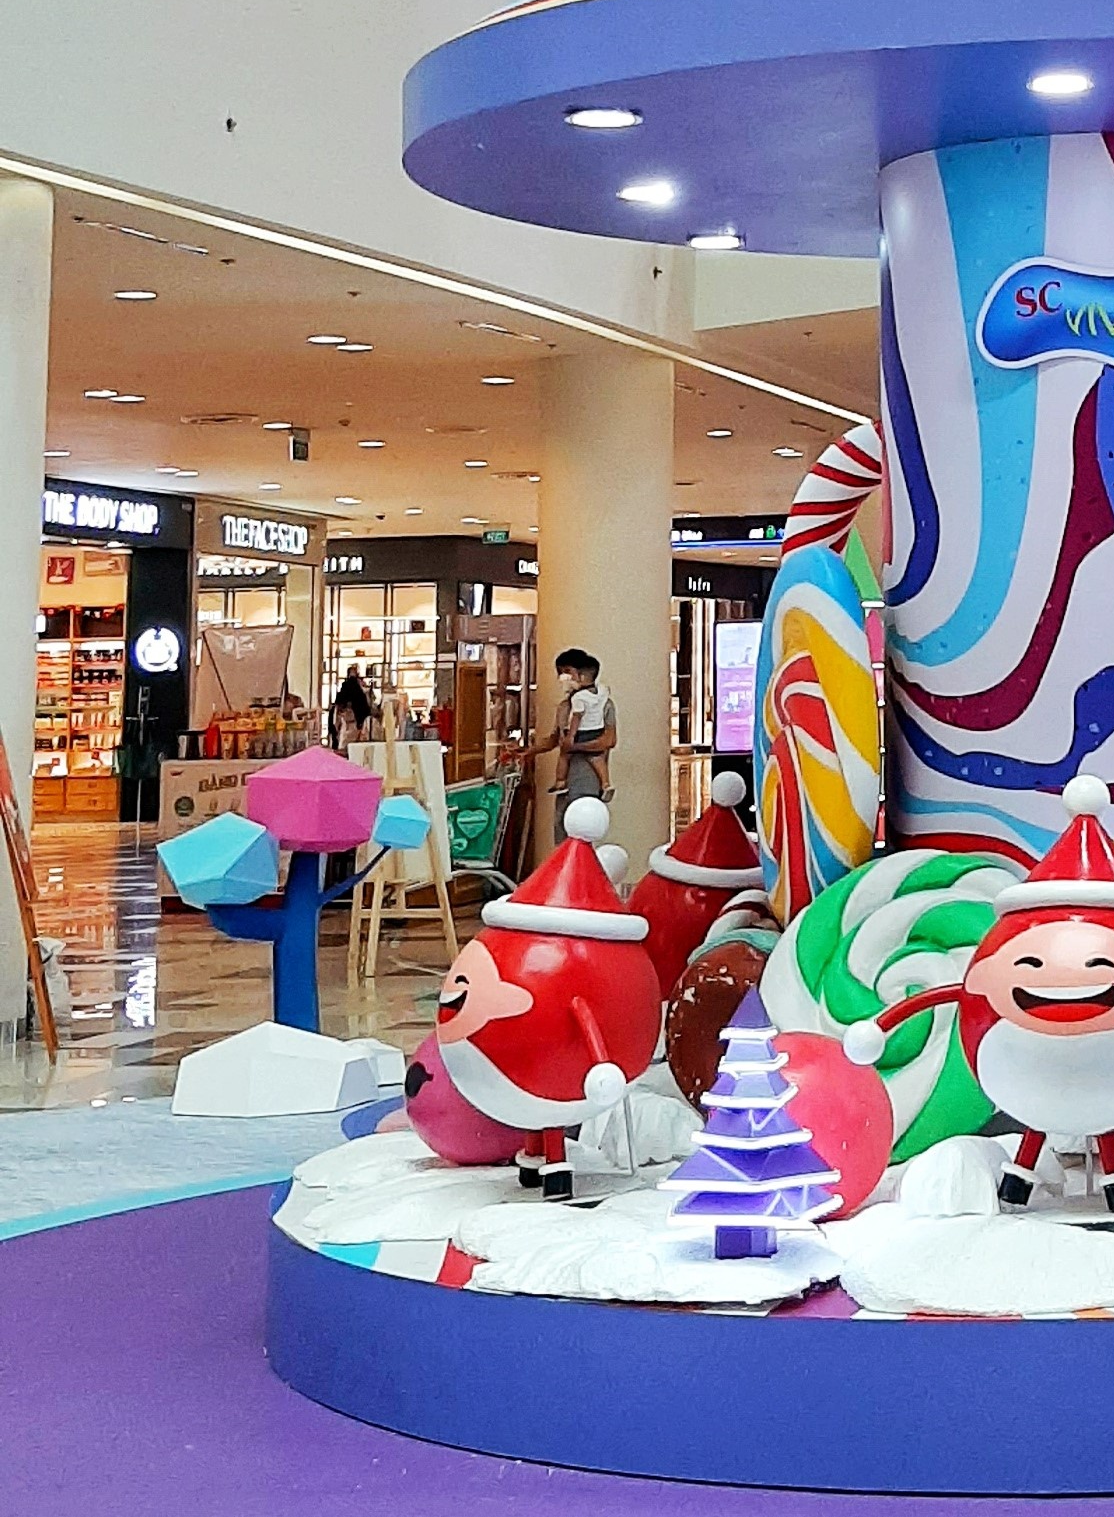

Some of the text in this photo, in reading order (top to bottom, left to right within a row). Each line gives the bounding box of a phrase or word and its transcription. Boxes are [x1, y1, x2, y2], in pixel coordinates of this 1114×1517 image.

[1015, 281, 1062, 317] SC
[43, 491, 158, 534] THE BODY SHOP
